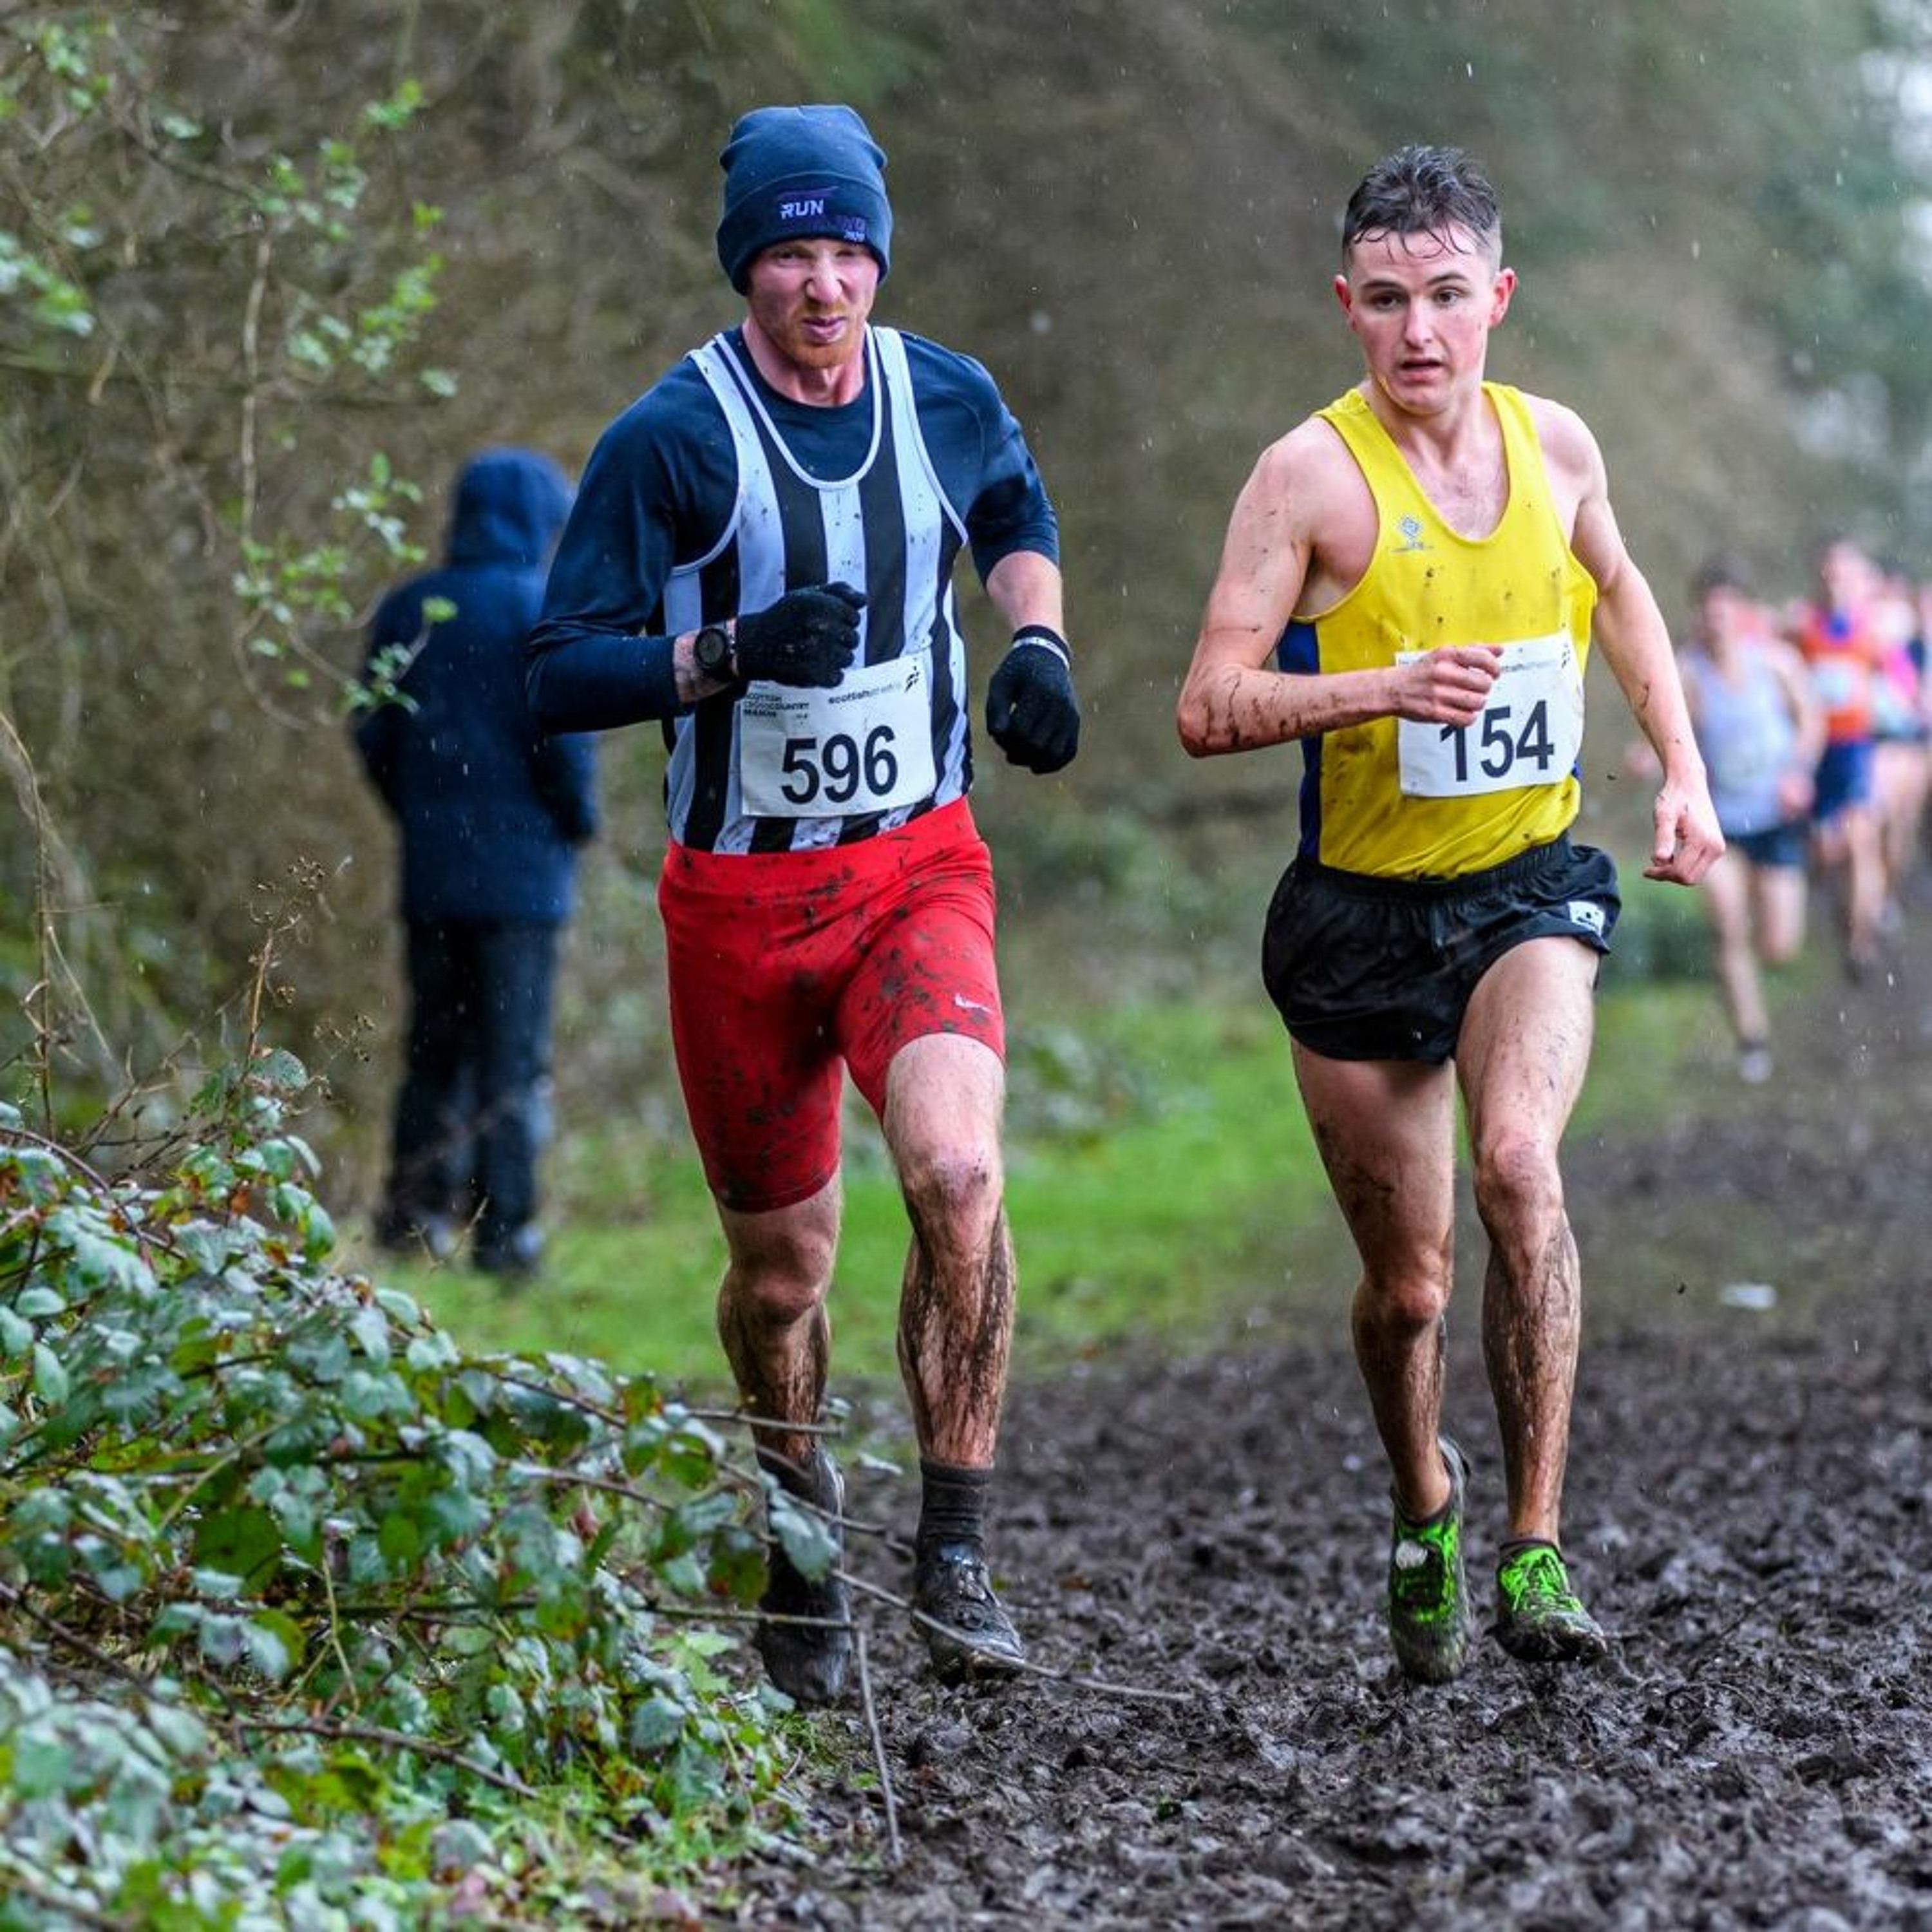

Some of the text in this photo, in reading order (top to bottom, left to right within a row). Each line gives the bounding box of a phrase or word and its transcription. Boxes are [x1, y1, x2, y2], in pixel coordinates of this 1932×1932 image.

[780, 198, 824, 220] RUN
[781, 725, 898, 804] 596
[1440, 699, 1555, 782] 154
